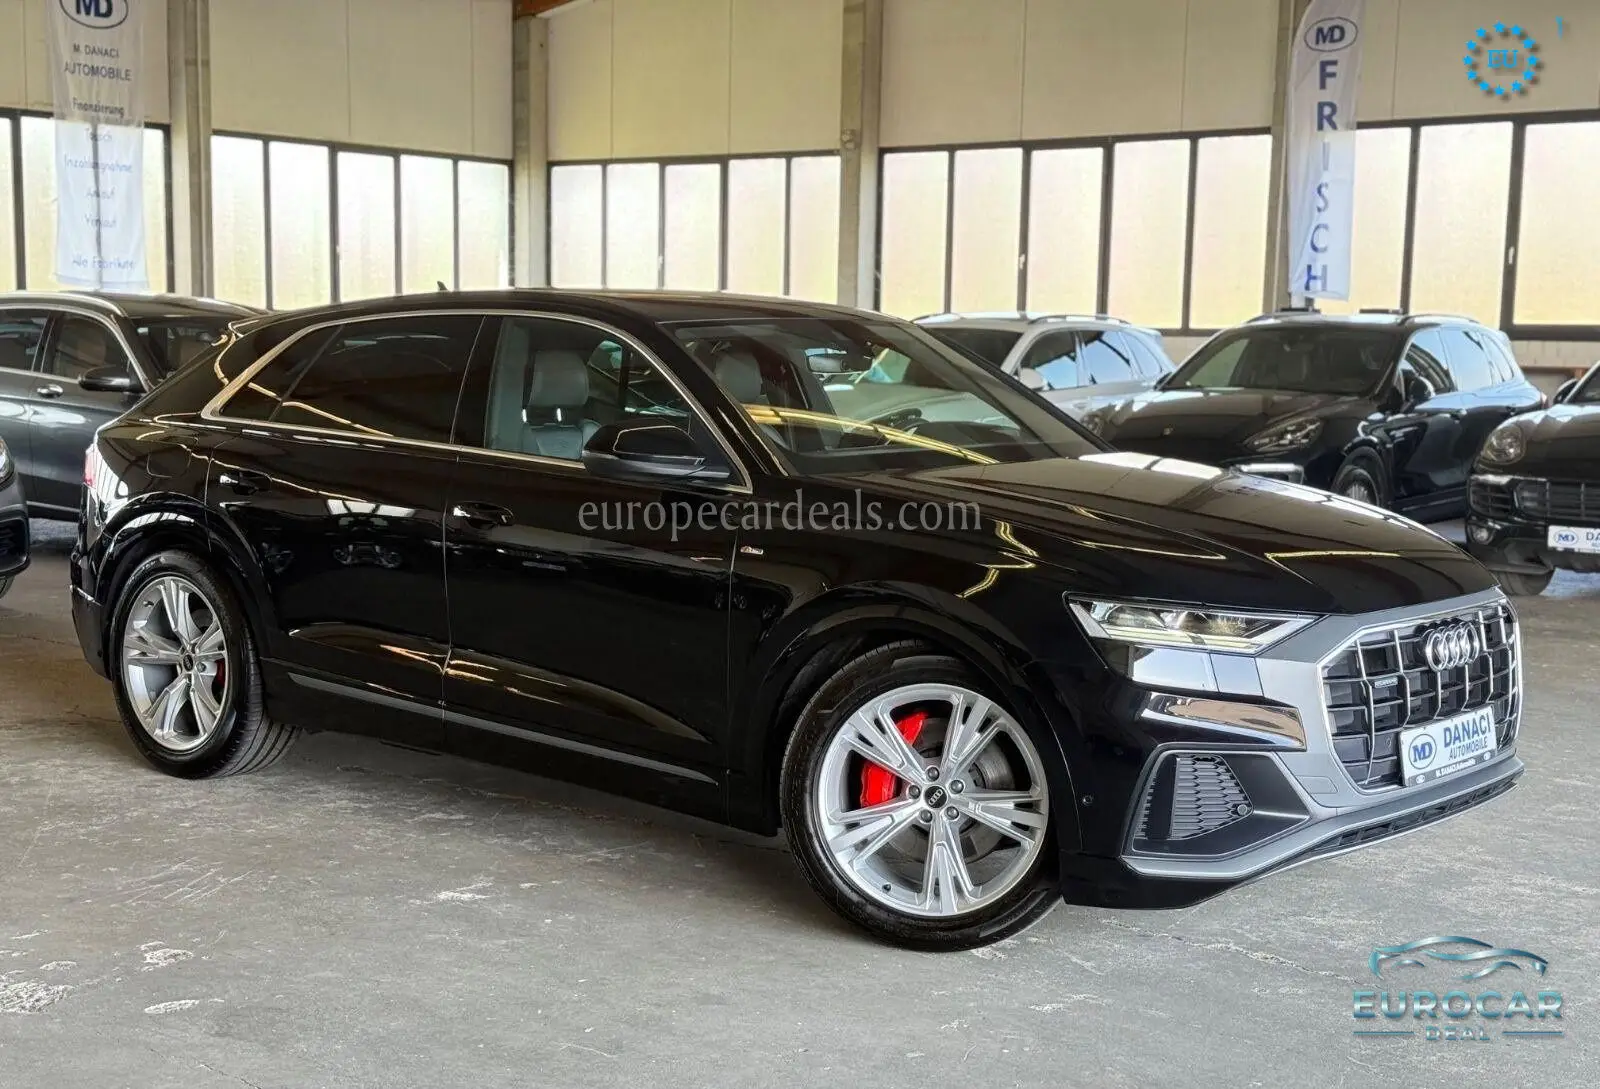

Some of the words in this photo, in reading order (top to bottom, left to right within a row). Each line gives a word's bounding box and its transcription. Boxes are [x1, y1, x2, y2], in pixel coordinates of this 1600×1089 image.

[75, 0, 113, 18] MD
[1315, 25, 1345, 44] MD
[84, 45, 119, 58] DANACI
[64, 61, 132, 81] AUTOMOBILE
[72, 97, 124, 118] Finanzierung
[1304, 59, 1338, 292] FRISCH
[1412, 741, 1434, 762] MD
[1443, 712, 1491, 748] DANACI
[1449, 736, 1488, 760] AUTOMOBILE
